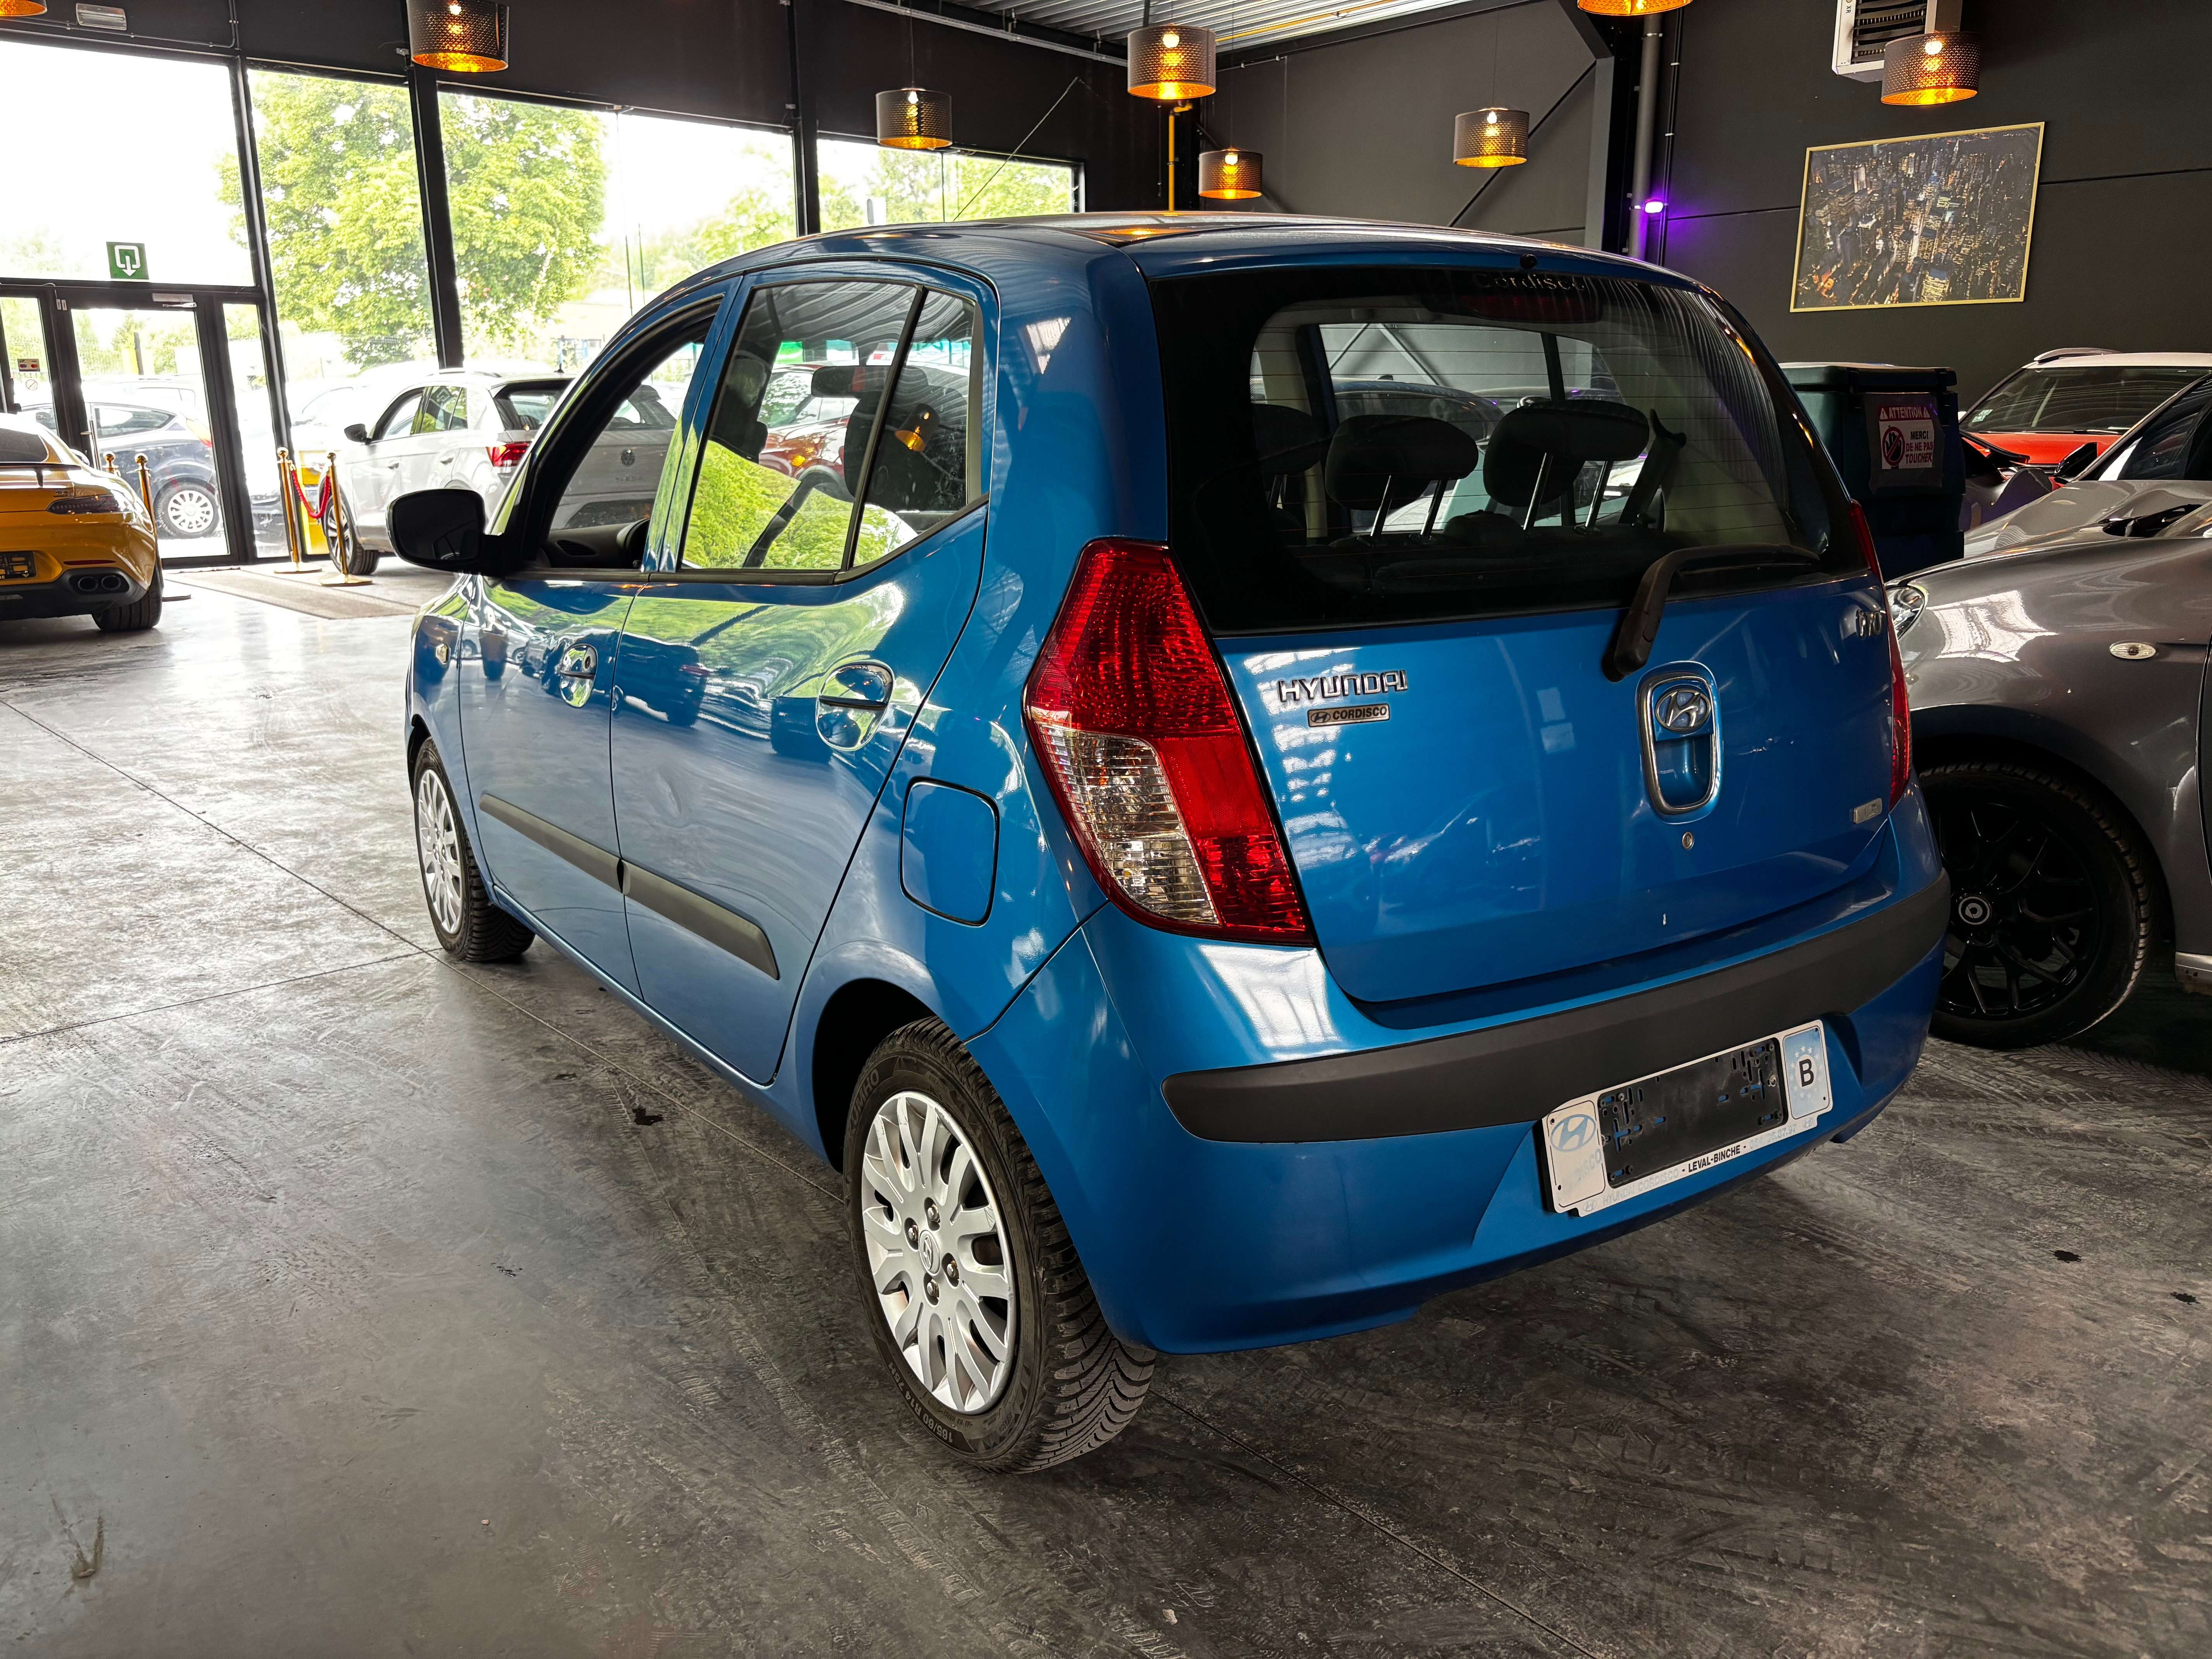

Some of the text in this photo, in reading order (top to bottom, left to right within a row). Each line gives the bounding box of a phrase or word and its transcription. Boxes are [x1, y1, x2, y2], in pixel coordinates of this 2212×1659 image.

[1889, 407, 1922, 419] ATTENTION
[1906, 441, 1933, 452] DE NE PAS
[1910, 430, 1929, 440] MERCI
[1905, 453, 1932, 464] TOUCHER
[1279, 670, 1408, 702] HYUNDAI
[1333, 706, 1387, 720] CORDISCO
[1799, 1059, 1814, 1087] B
[1688, 1145, 1740, 1172] LEVAL-BINCHE
[888, 1362, 904, 1391] 75H
[905, 1391, 922, 1417] R14
[923, 1413, 953, 1443] 165/60
